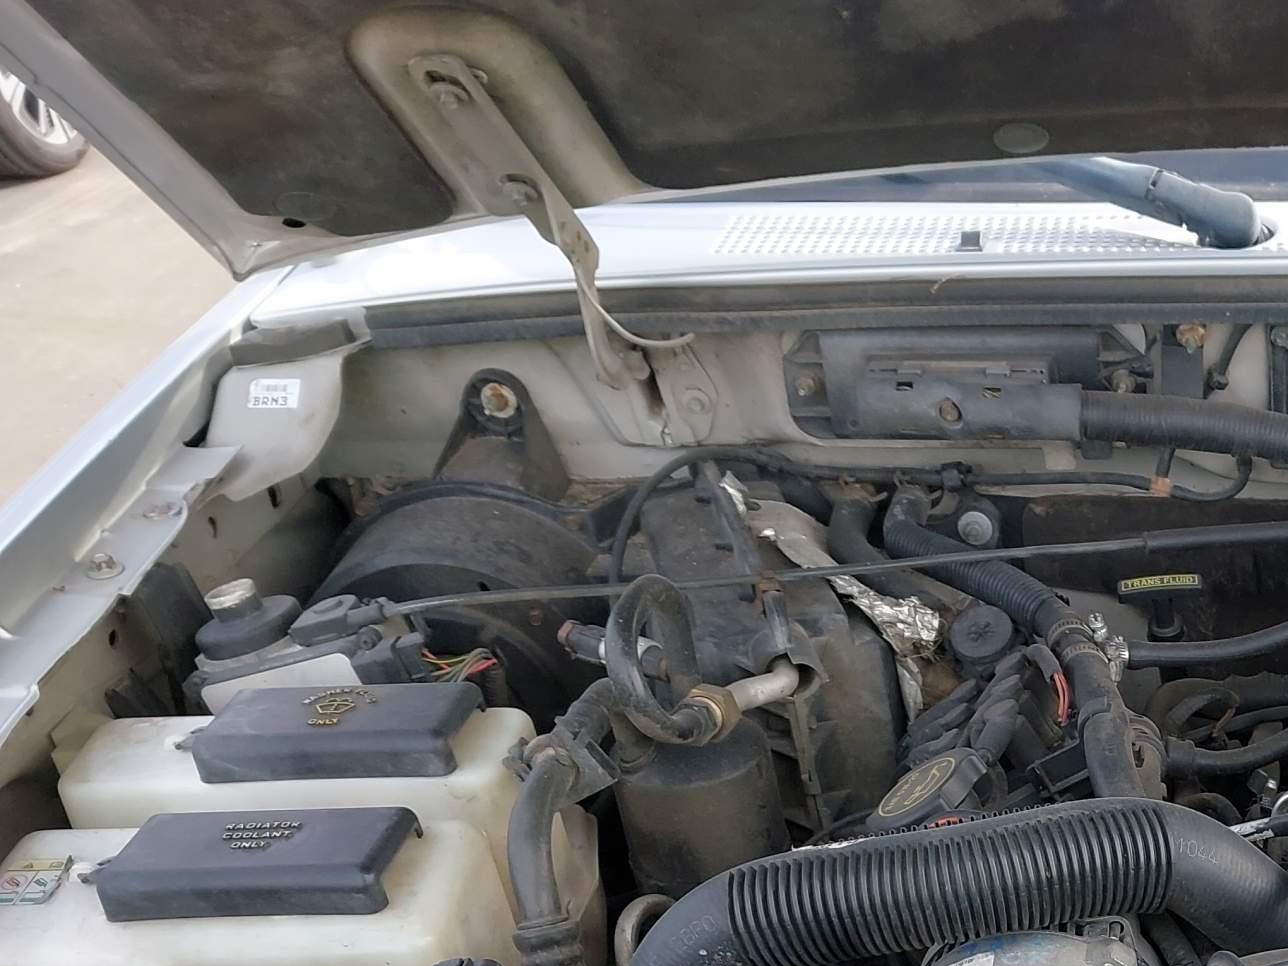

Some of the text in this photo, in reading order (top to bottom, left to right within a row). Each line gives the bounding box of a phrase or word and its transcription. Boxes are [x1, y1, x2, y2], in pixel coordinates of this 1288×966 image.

[1127, 576, 1193, 587] TRANS FLUID
[225, 822, 300, 830] RADIATOR
[223, 831, 291, 839] COOLANT
